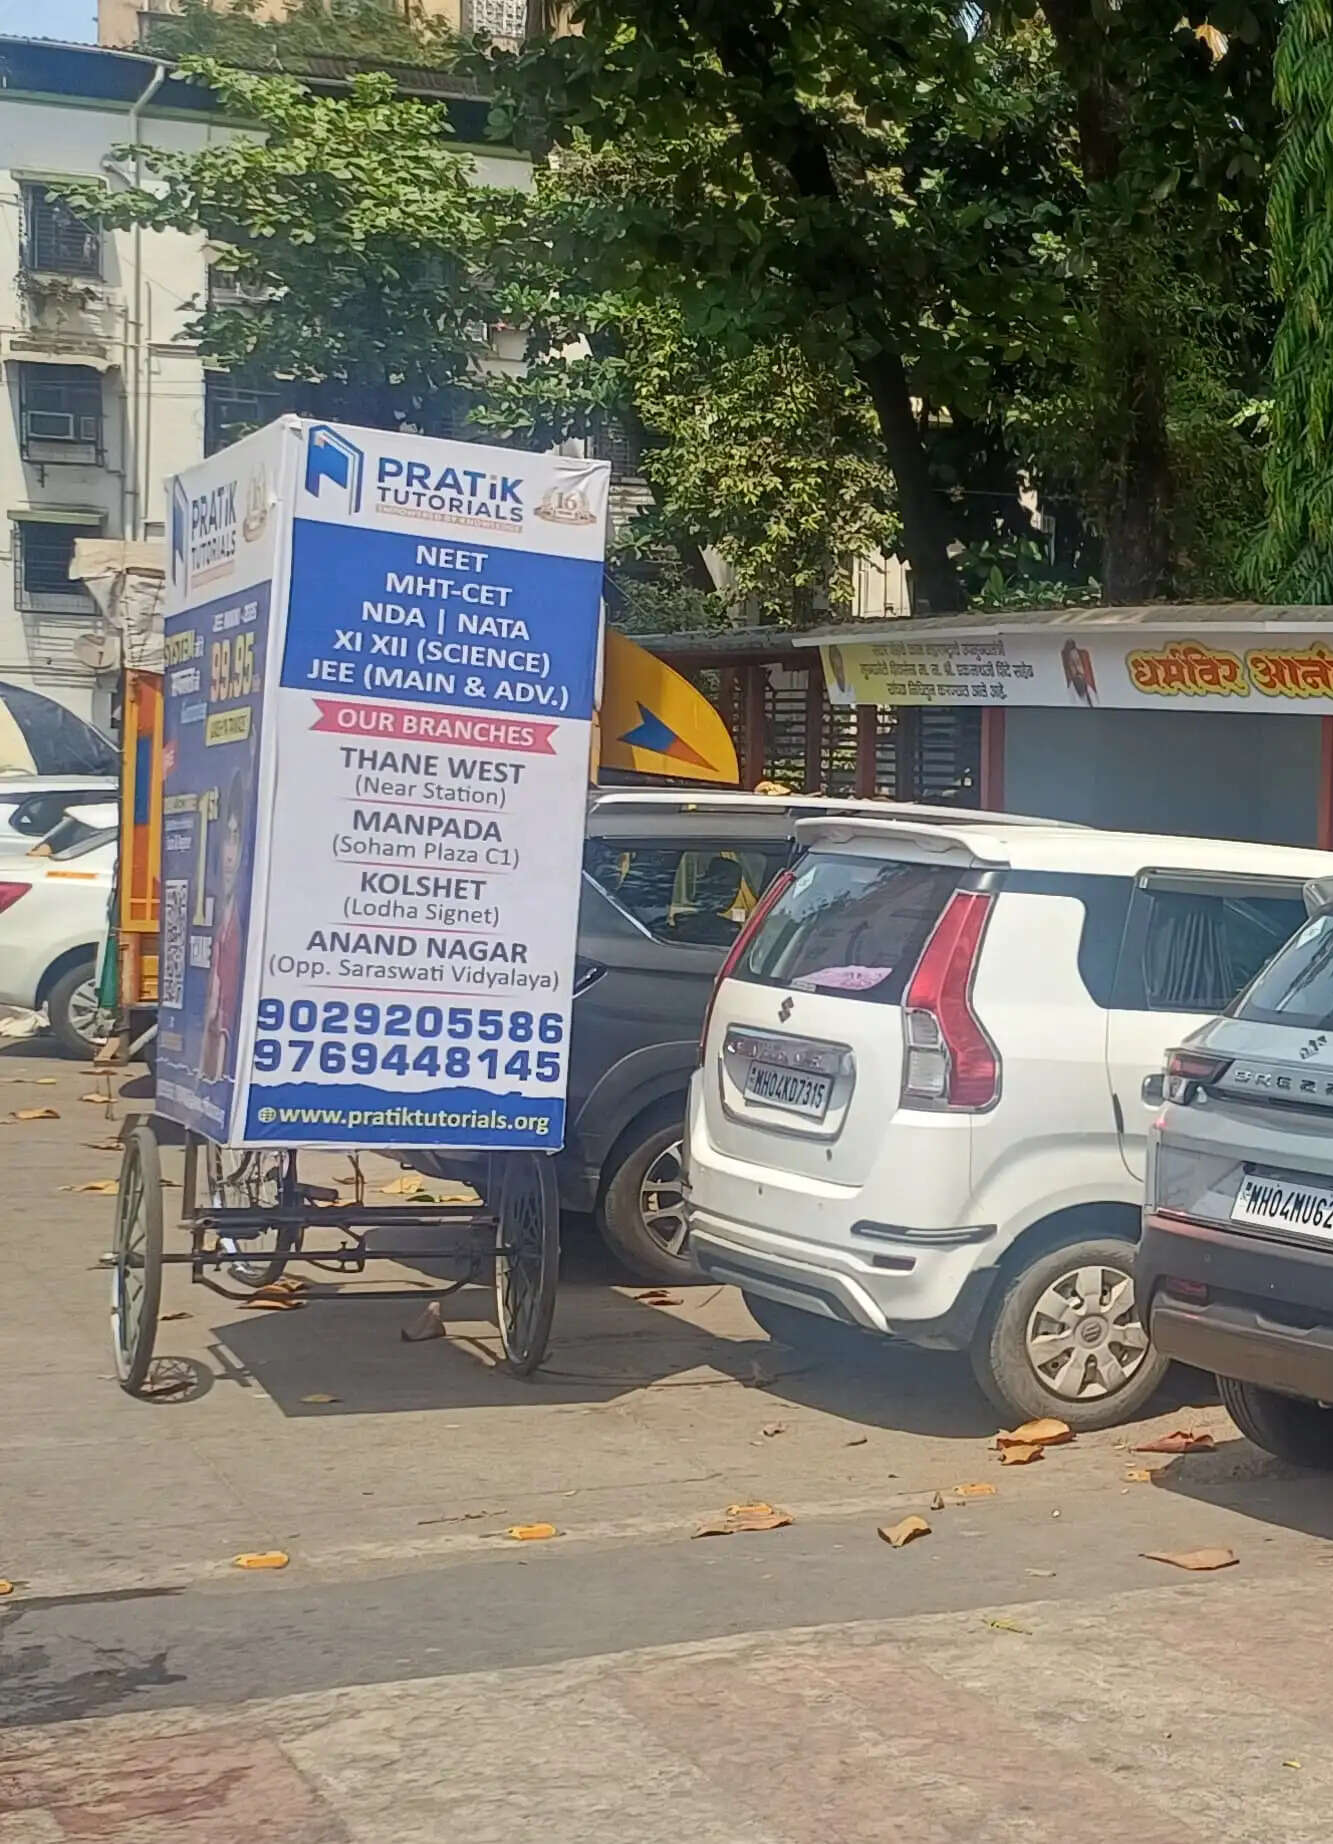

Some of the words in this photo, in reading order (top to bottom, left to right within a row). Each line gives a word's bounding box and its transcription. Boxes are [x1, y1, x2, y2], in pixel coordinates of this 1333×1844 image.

[377, 486, 524, 524] TUTORIALS
[191, 530, 237, 570] TUTORIALS
[416, 545, 488, 573] NEET
[386, 572, 513, 607] MHT-CET
[362, 601, 426, 629] NDA
[458, 613, 531, 640] NATA
[333, 629, 362, 652] XI
[371, 634, 407, 658] XII
[417, 638, 551, 678] (SCIENCE)
[307, 658, 355, 683] JEE
[363, 663, 456, 694] (MAIN
[464, 676, 486, 698] &
[494, 680, 569, 711] ADV.)
[337, 708, 394, 733] OUR
[402, 714, 535, 746] BRANCHES
[340, 747, 440, 777] THANE
[449, 757, 526, 785] WEST
[355, 773, 417, 798] (Near
[423, 780, 507, 809] Station)
[352, 809, 503, 843] MANPADA
[332, 833, 416, 859] (Soham
[424, 841, 478, 864] Plaza
[485, 847, 520, 870] C1)
[360, 871, 487, 901] KOLSHET
[343, 896, 418, 920] (Lodha
[426, 902, 499, 928] Signet)
[306, 930, 417, 958] ANAND
[427, 936, 528, 964] NAGAR
[269, 953, 331, 980] (Opp.
[339, 958, 444, 983] Saraswati
[451, 964, 560, 992] Vidyalaya)
[257, 998, 564, 1044] 9029205586
[254, 1038, 561, 1083] 9769448145
[279, 1106, 550, 1135] www.pratiktutorials.org
